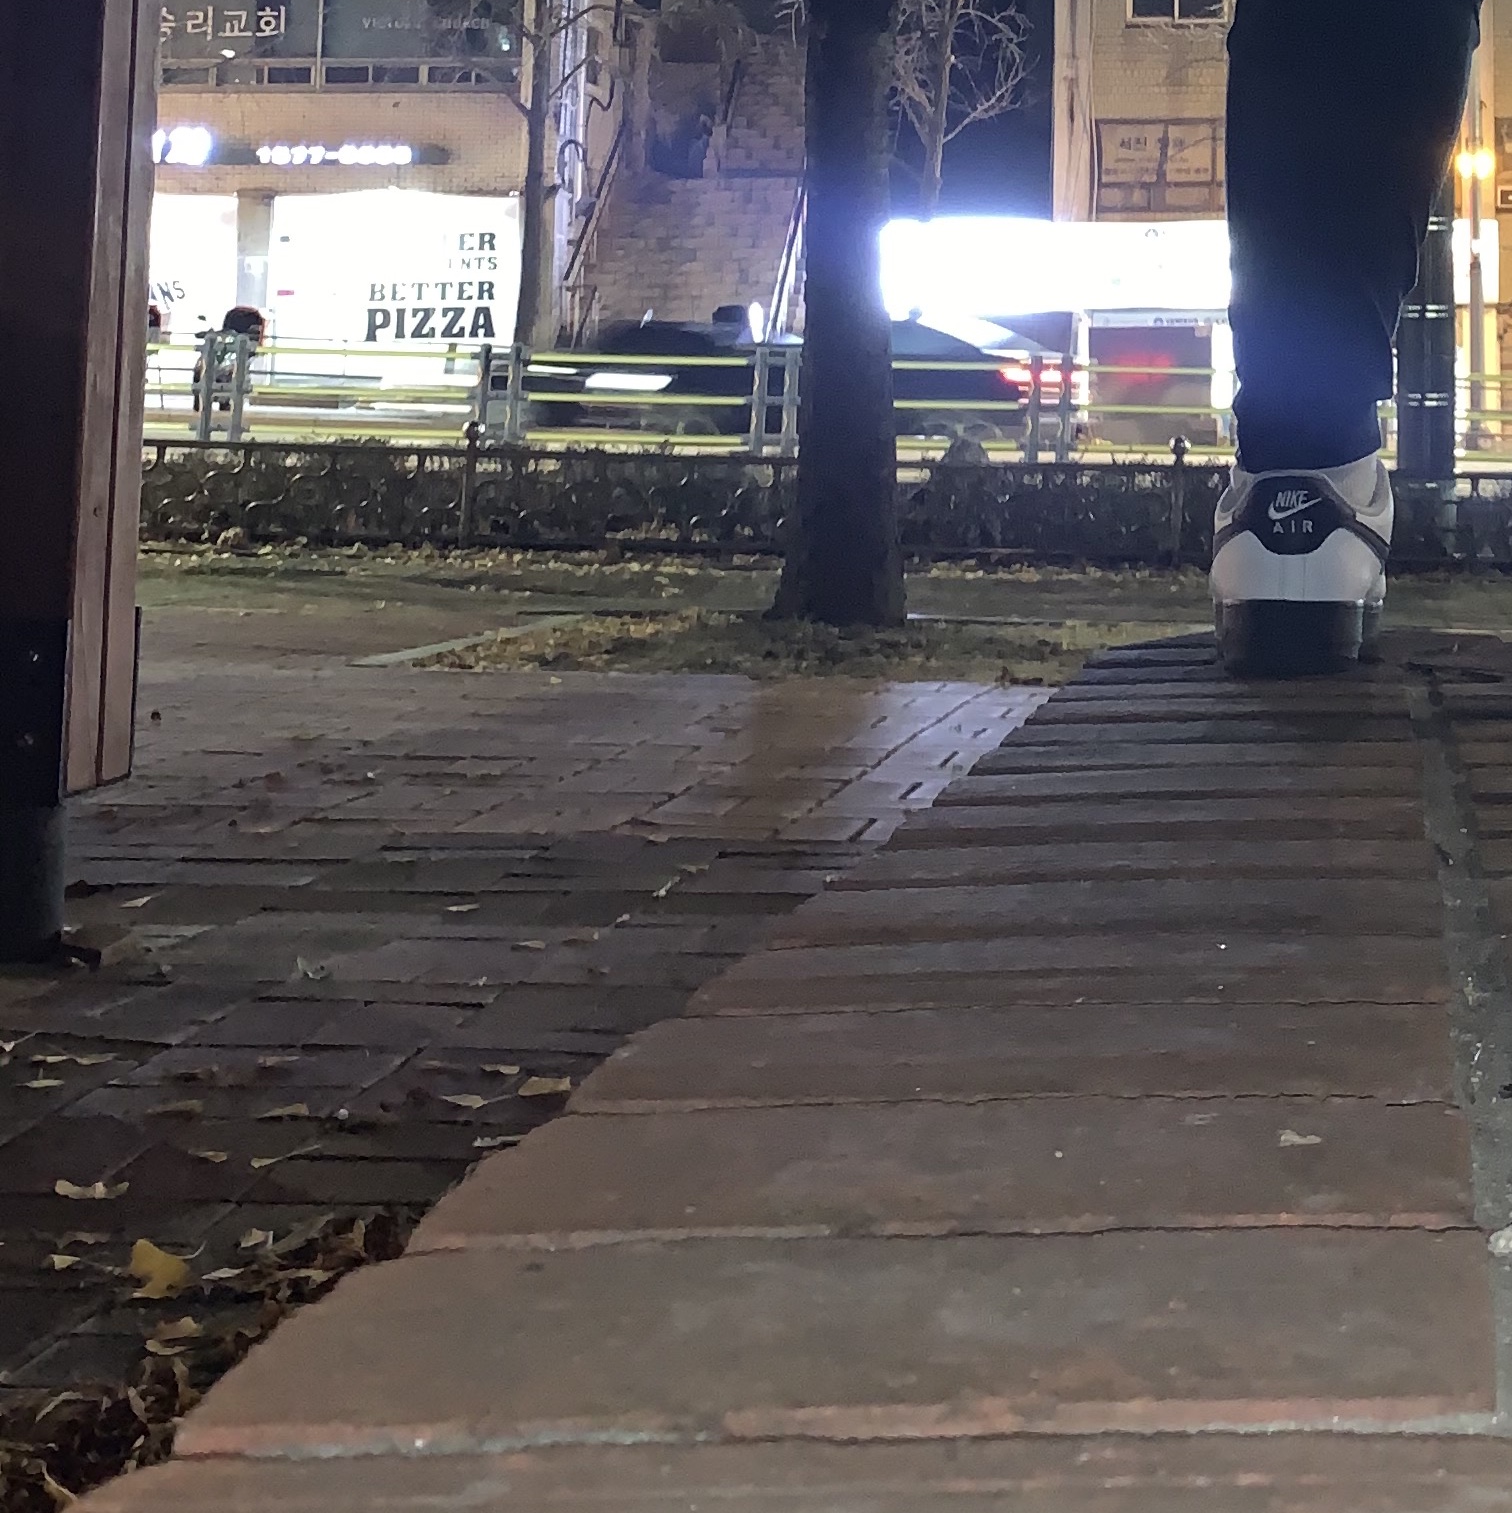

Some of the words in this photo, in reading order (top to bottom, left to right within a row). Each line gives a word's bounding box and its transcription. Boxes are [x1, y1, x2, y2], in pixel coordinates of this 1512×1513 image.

[368, 280, 496, 302] BETTER
[363, 305, 497, 342] PIZZA
[1275, 490, 1309, 508] NIKE
[1273, 519, 1313, 534] AIR
